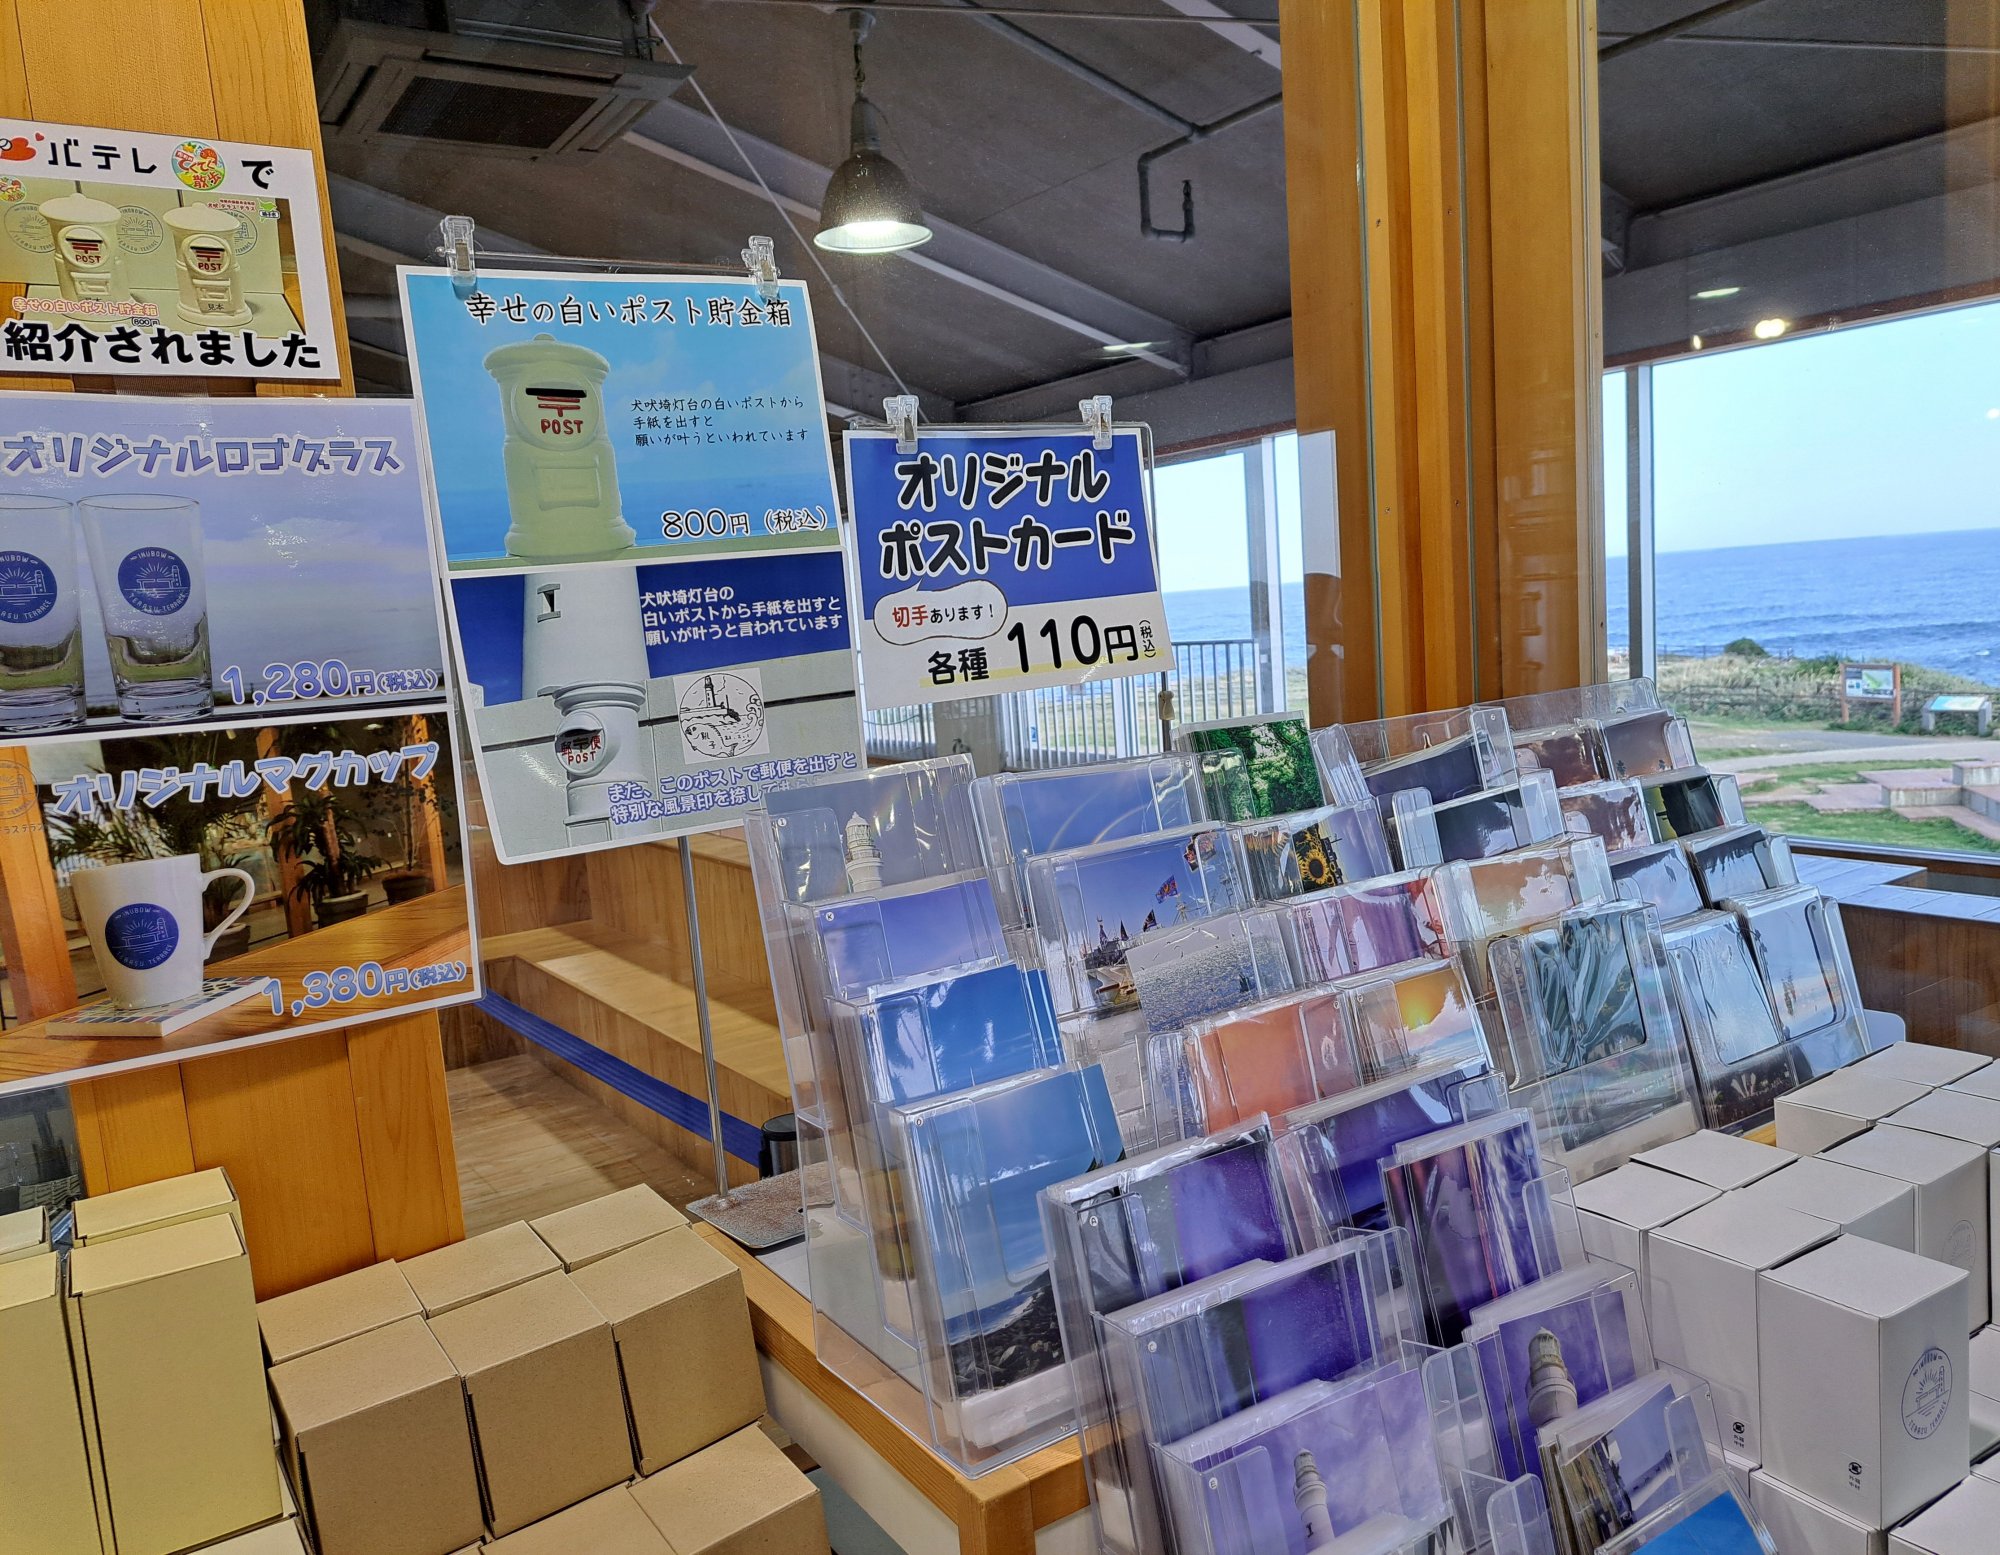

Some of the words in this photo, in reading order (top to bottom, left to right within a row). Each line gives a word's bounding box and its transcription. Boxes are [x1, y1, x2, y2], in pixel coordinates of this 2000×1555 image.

[241, 160, 274, 190] で
[75, 254, 101, 263] POST
[198, 262, 222, 271] POST
[466, 292, 792, 328] 幸せの白いポスト貯金箱
[4, 321, 321, 369] 紹介されました
[631, 396, 804, 412] 犬吠埼灯台の白いポストから
[541, 419, 584, 435] POST
[633, 415, 713, 430] 手紙を出すと
[635, 429, 808, 447] 願いが叶うといわれています
[3, 435, 402, 475] オリジナルロゴグラス
[895, 449, 1110, 511] オリジナル
[138, 550, 168, 560] INUBOW
[879, 510, 1135, 580] ポストカード
[640, 586, 735, 608] 犬吠埼灯台の
[643, 596, 842, 627] 白いポストから手紙を出すと
[645, 614, 843, 646] 願いが叶うと言われています
[927, 647, 989, 686] 各種
[1007, 614, 1139, 674] 110円
[567, 751, 596, 765] POST
[53, 741, 438, 816] オリジナルマグカップ
[122, 907, 152, 917] INUBOW
